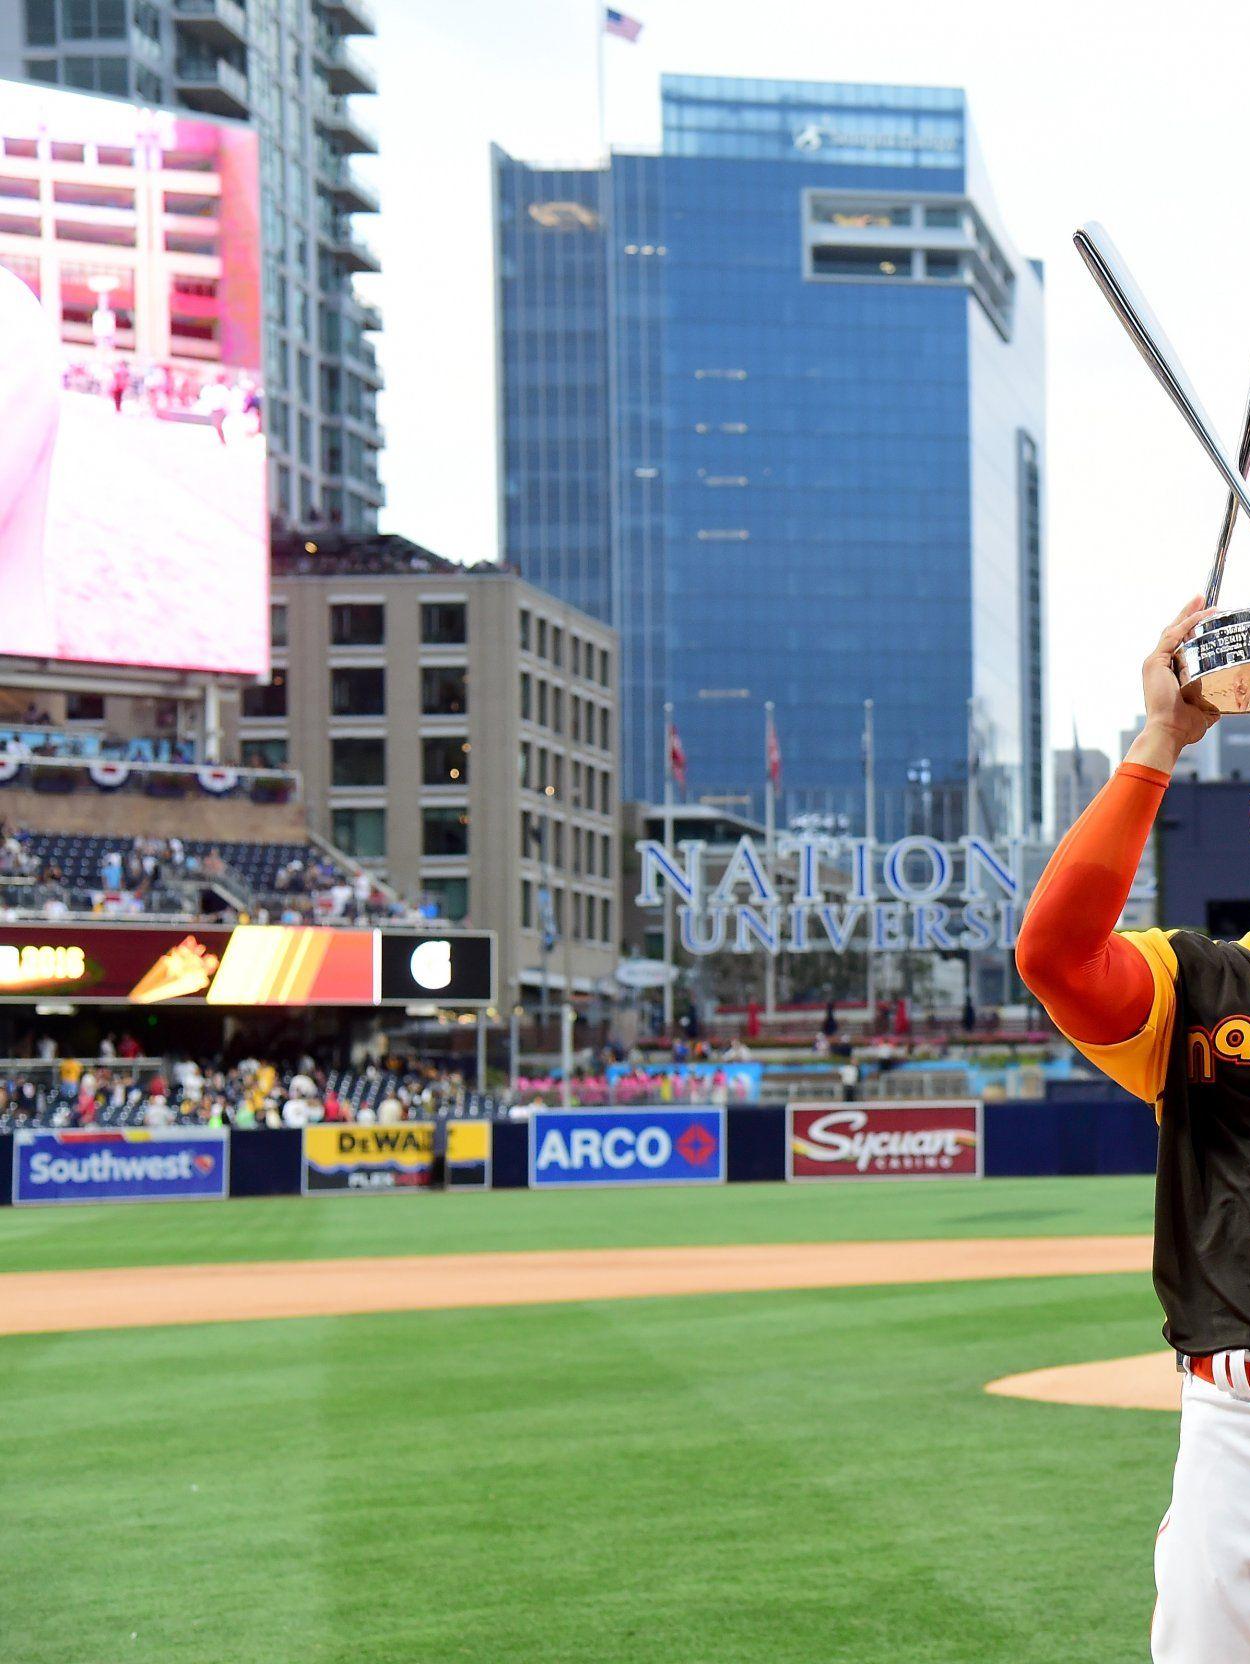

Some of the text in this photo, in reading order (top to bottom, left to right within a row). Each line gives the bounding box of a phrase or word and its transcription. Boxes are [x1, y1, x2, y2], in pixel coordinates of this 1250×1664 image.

[1218, 632, 1248, 648] DERBY
[634, 834, 1157, 908] NATION
[676, 902, 1022, 956] UNIVERSI
[536, 1125, 672, 1170] ARCO
[807, 1110, 962, 1171] Sycuan
[30, 1150, 193, 1184] Southwest
